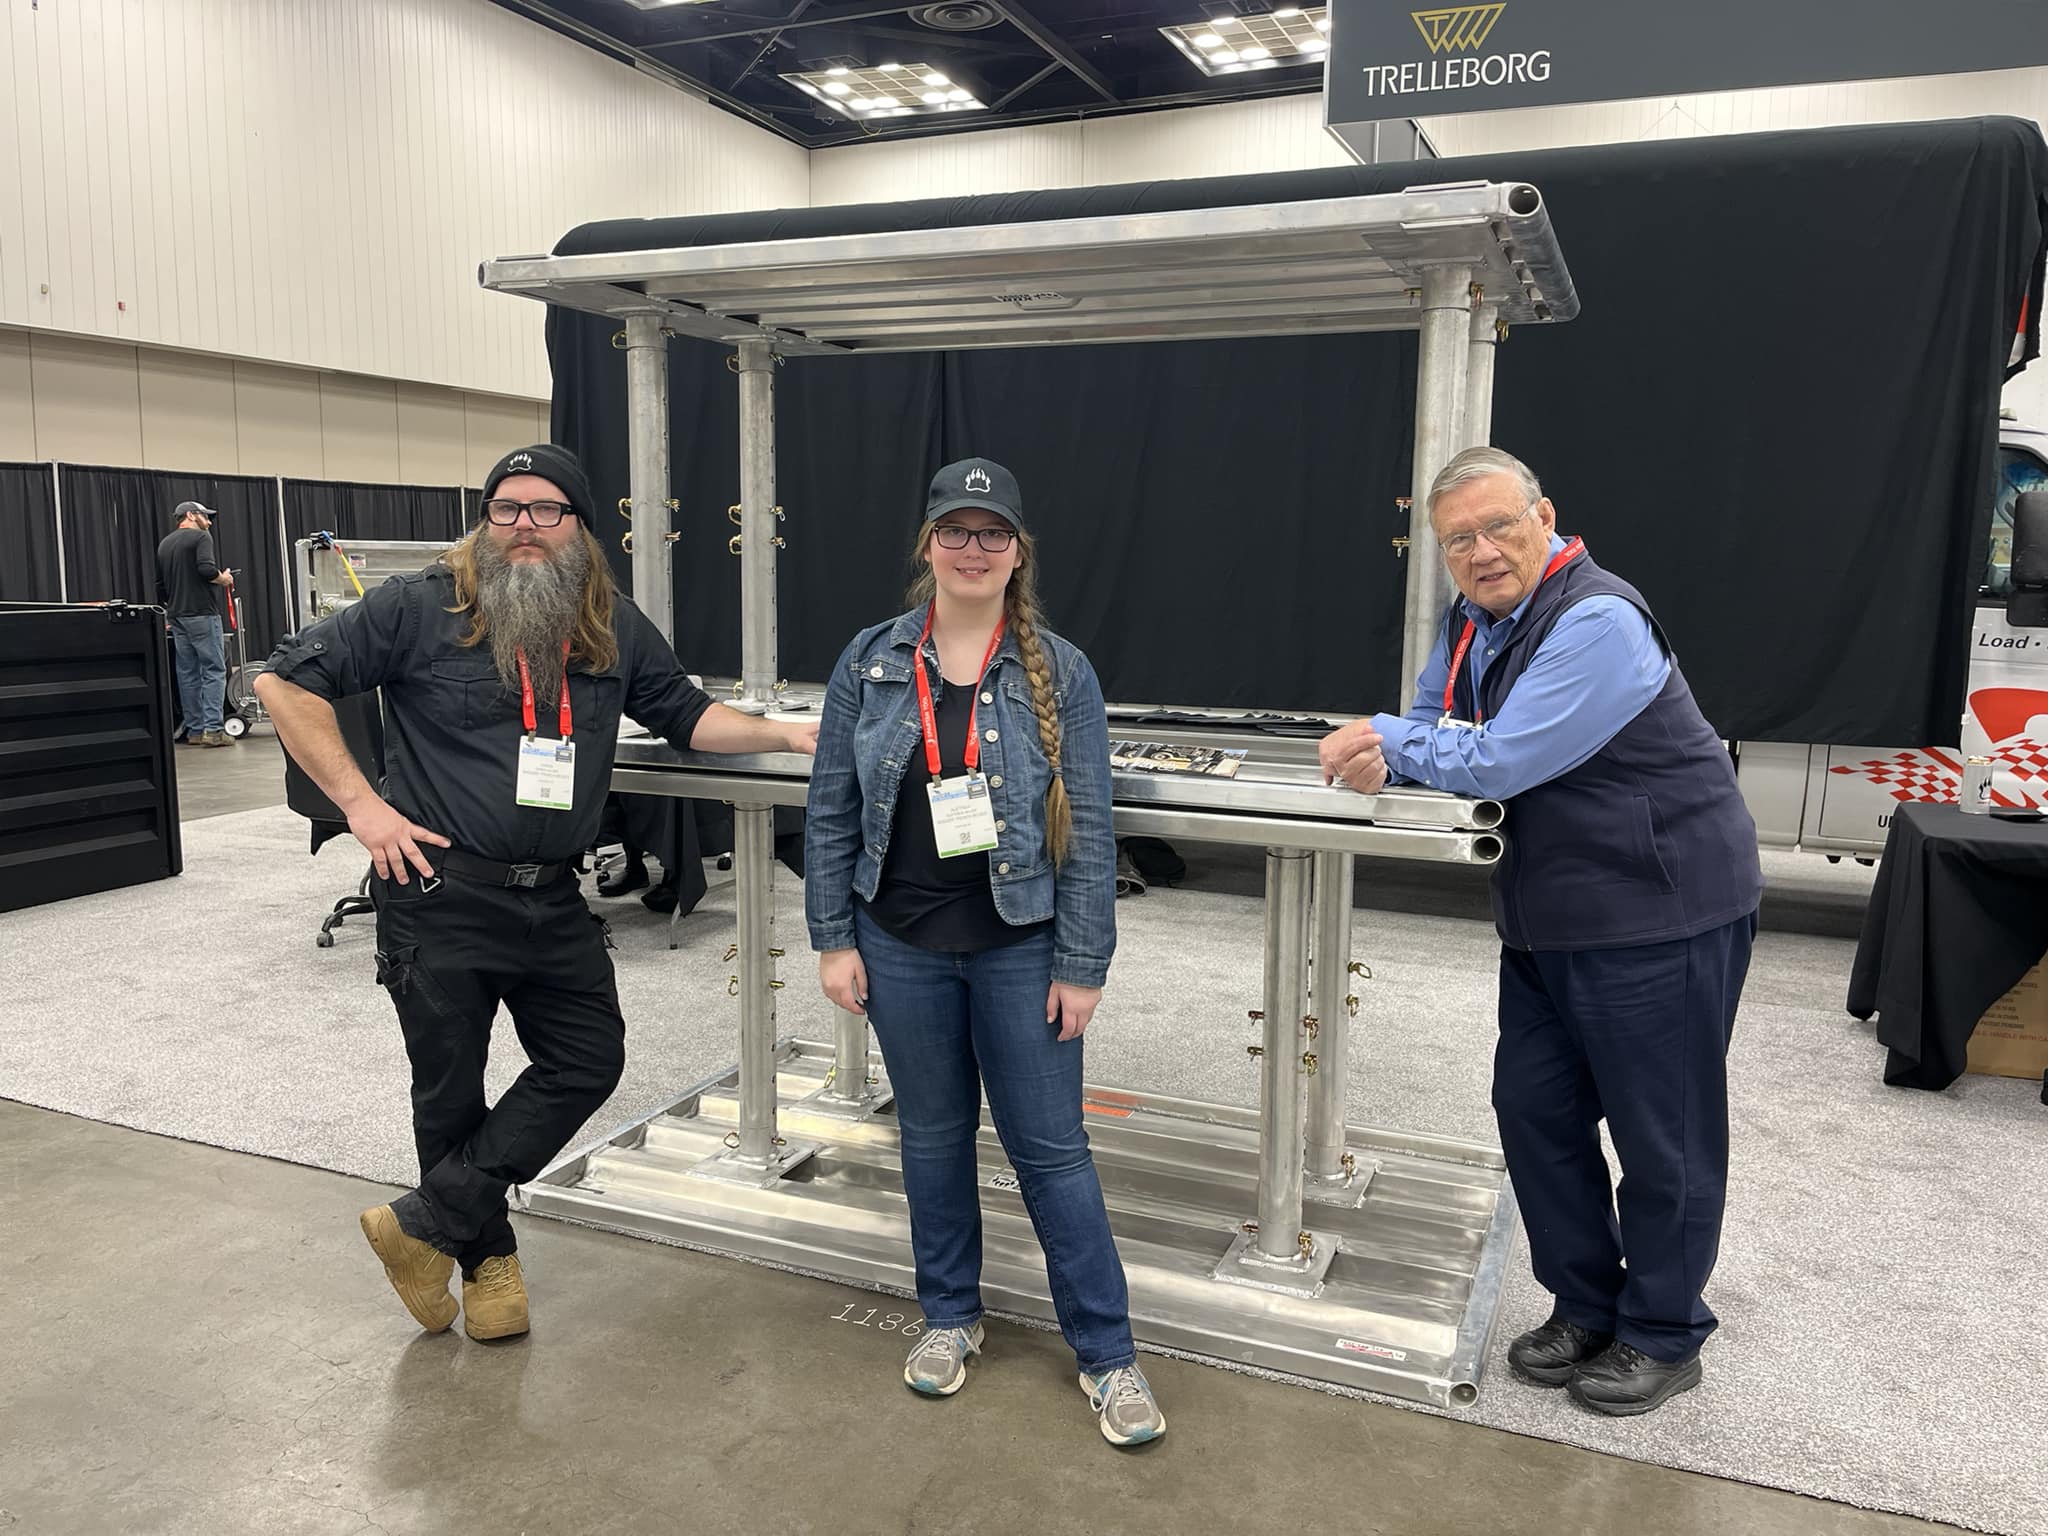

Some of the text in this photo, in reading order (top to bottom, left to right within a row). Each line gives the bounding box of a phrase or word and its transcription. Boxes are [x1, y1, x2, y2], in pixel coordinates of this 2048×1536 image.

[1363, 50, 1550, 96] TRELLEBORG
[1979, 633, 2030, 649] Load
[830, 1303, 924, 1336] 1136
